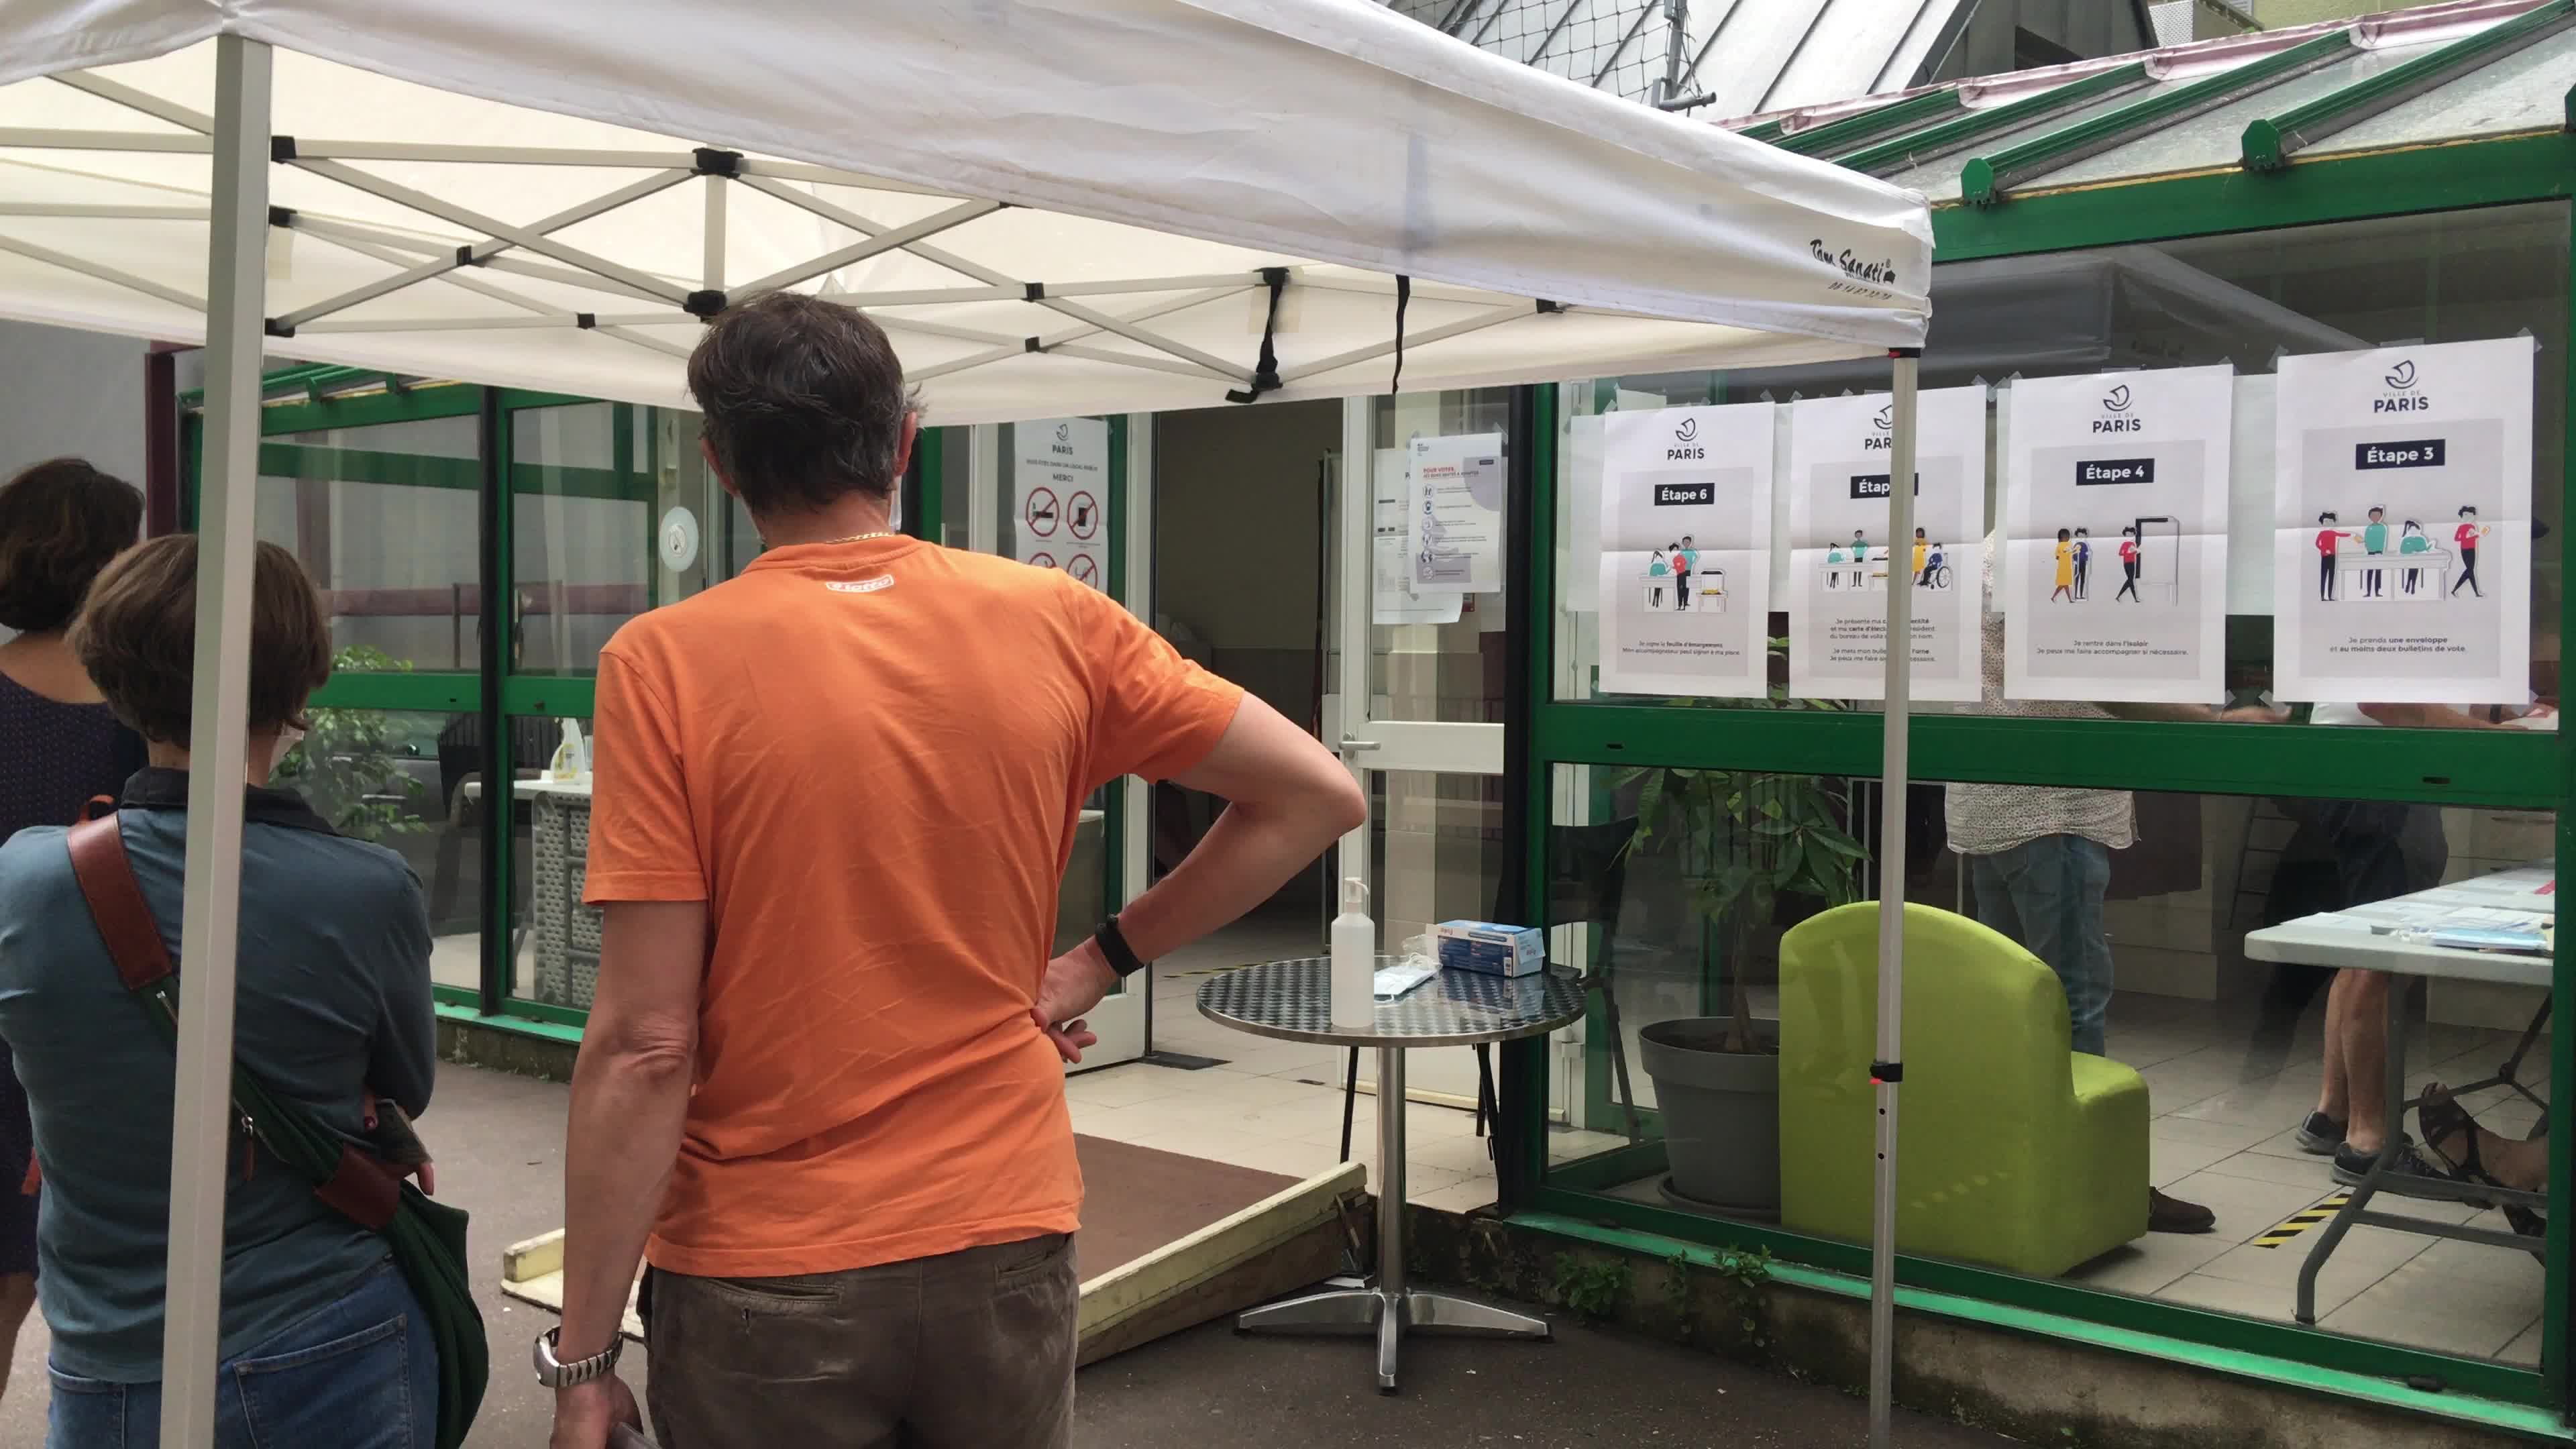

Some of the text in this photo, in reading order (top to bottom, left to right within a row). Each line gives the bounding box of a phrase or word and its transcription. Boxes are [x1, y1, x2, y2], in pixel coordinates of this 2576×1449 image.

[2374, 396, 2429, 413] PARIS
[2092, 418, 2141, 433] PARIS
[1052, 445, 1073, 455] PARIS
[1865, 437, 1892, 450] PAR
[1667, 448, 1705, 460] PARIS
[2367, 446, 2434, 464] Étape 3
[1053, 473, 1074, 483] MERCI
[2086, 464, 2144, 481] Étape 4
[1859, 478, 1890, 494] Étap
[1662, 487, 1707, 502] Étape 6
[2359, 637, 2387, 645] prends
[2406, 637, 2448, 645] enveloppe
